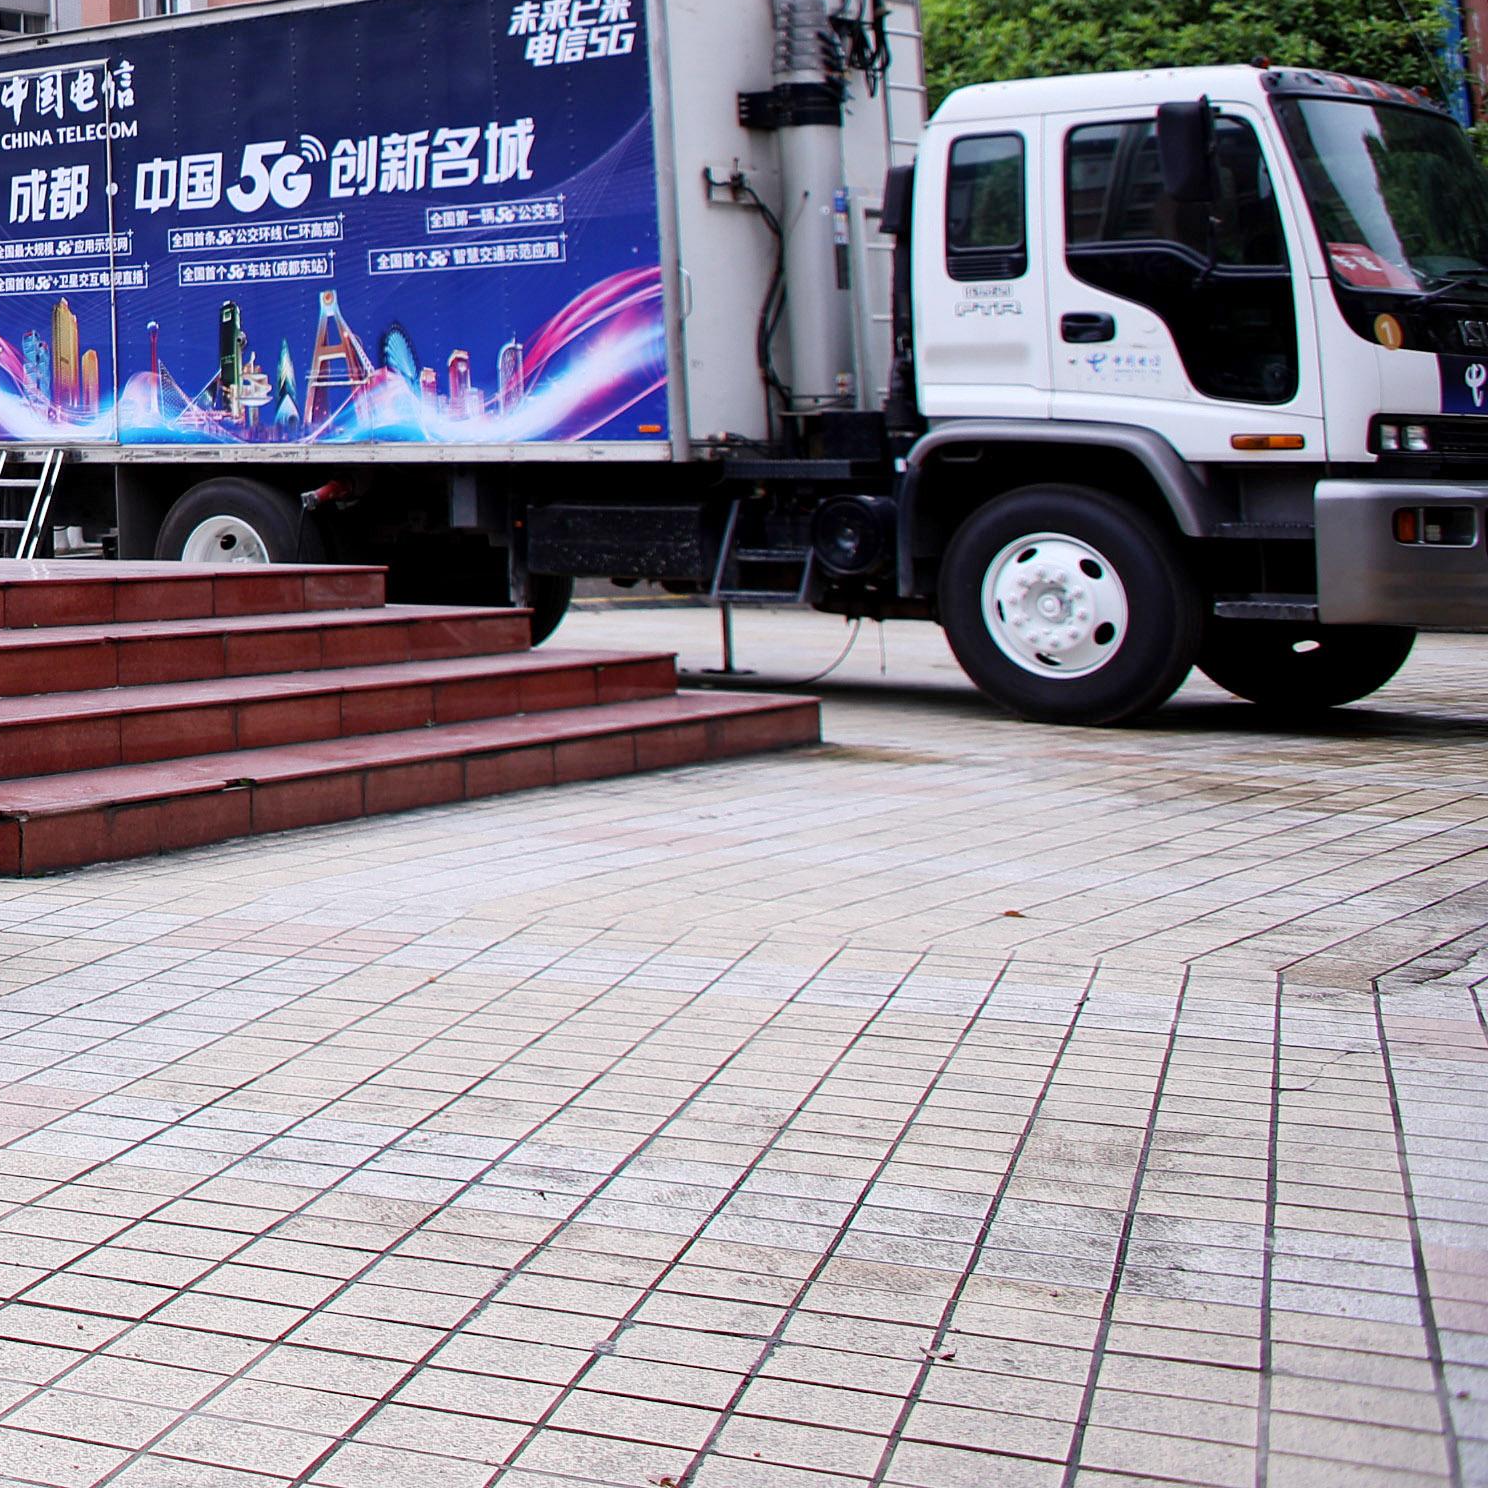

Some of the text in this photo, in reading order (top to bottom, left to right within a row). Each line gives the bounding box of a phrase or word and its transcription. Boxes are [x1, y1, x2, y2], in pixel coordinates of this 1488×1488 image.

[525, 22, 637, 67] 电信5G
[1, 60, 135, 125] 中国电信
[1, 120, 138, 151] CHINA TELECOM
[9, 164, 90, 223] 成都
[1380, 320, 1394, 345] 1
